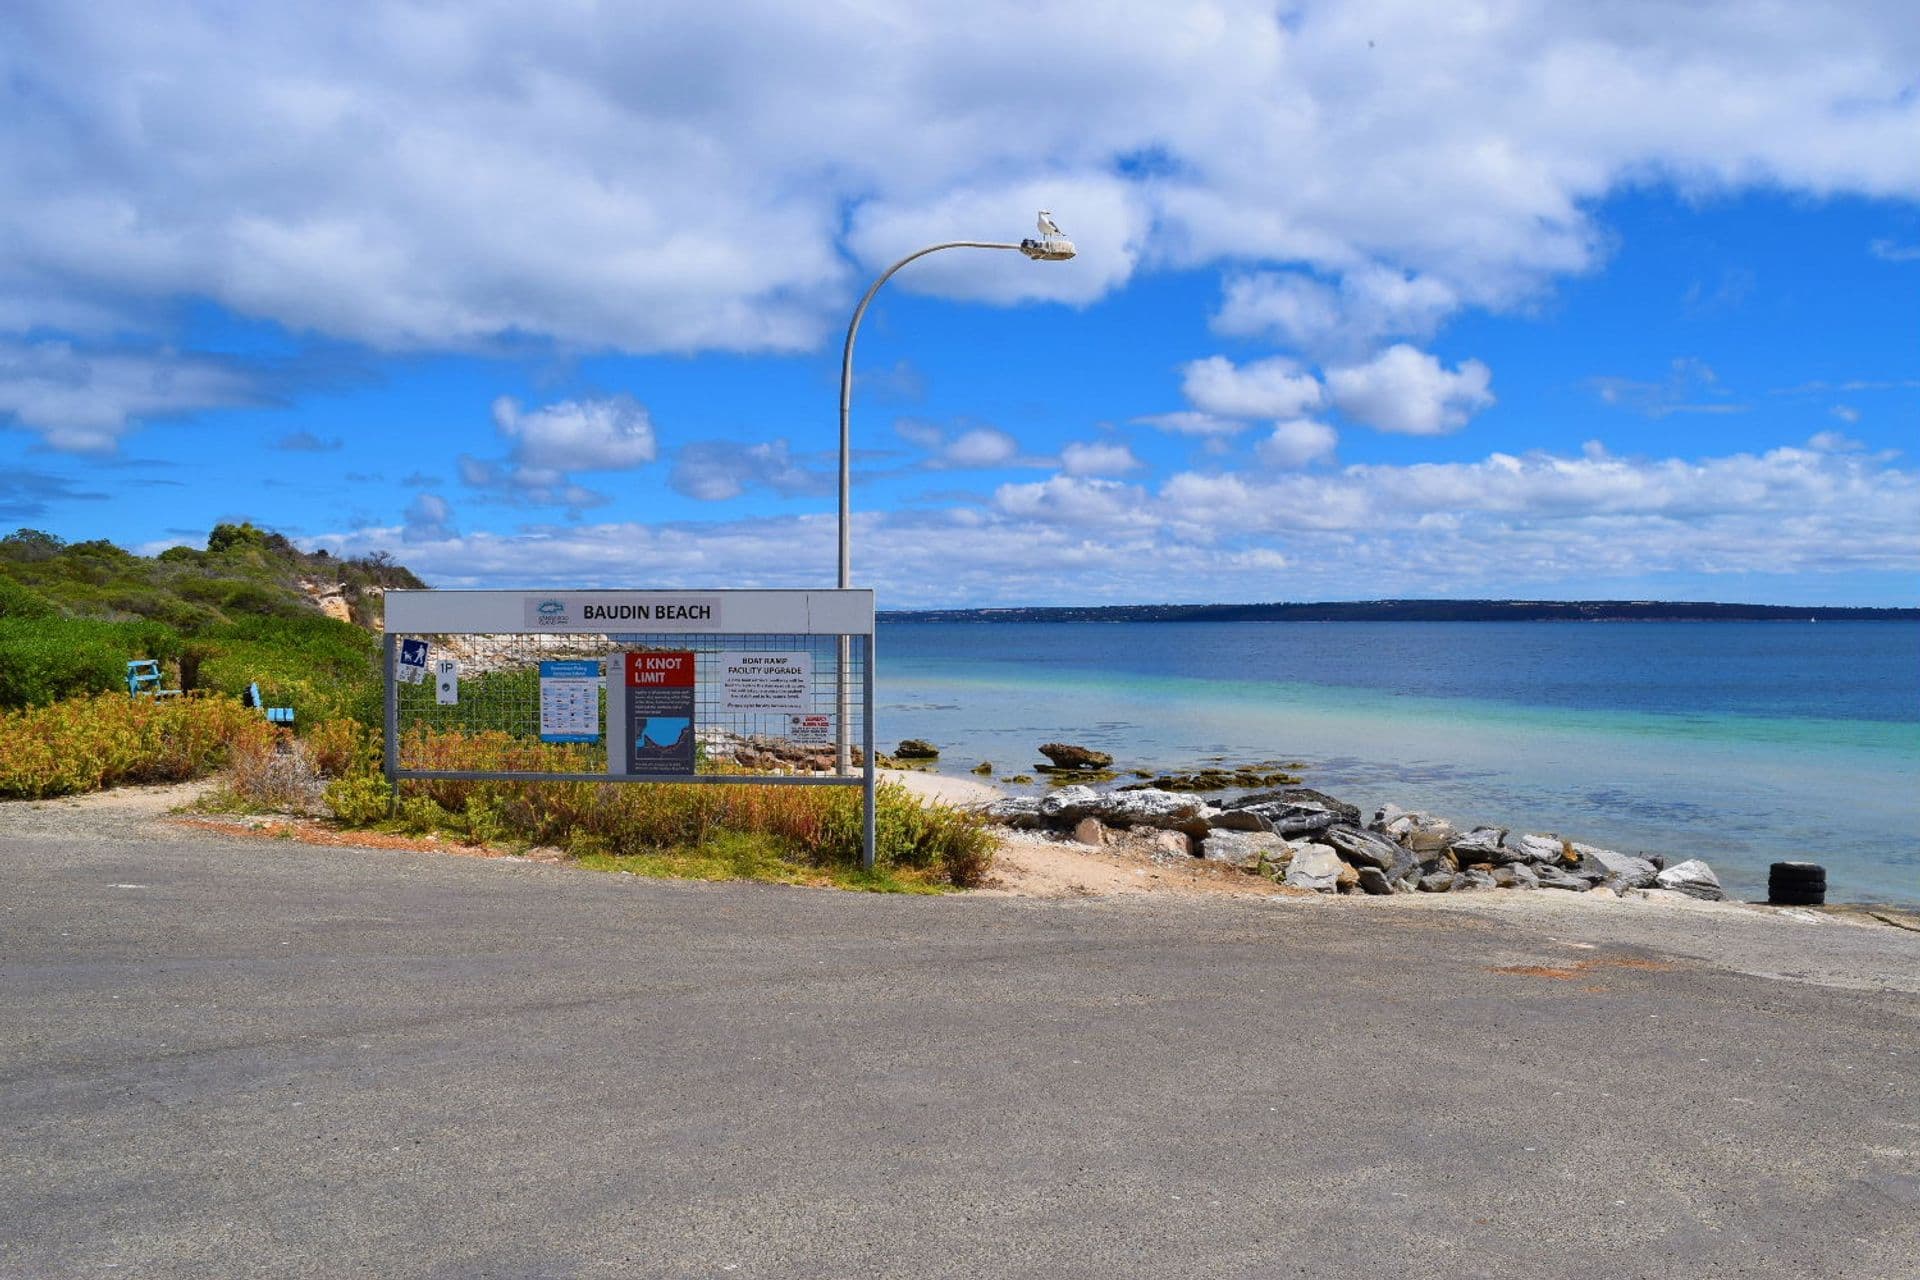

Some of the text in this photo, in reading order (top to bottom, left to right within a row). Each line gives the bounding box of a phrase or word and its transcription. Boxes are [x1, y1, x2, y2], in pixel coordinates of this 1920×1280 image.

[583, 605, 711, 619] BAUDIN BEACH
[635, 658, 643, 669] 4
[646, 658, 682, 669] KNOT
[742, 657, 788, 665] BOAT RAMP
[441, 663, 453, 673] 1P
[728, 667, 802, 675] FACILITY UPGRADE
[635, 672, 666, 683] LIMIT
